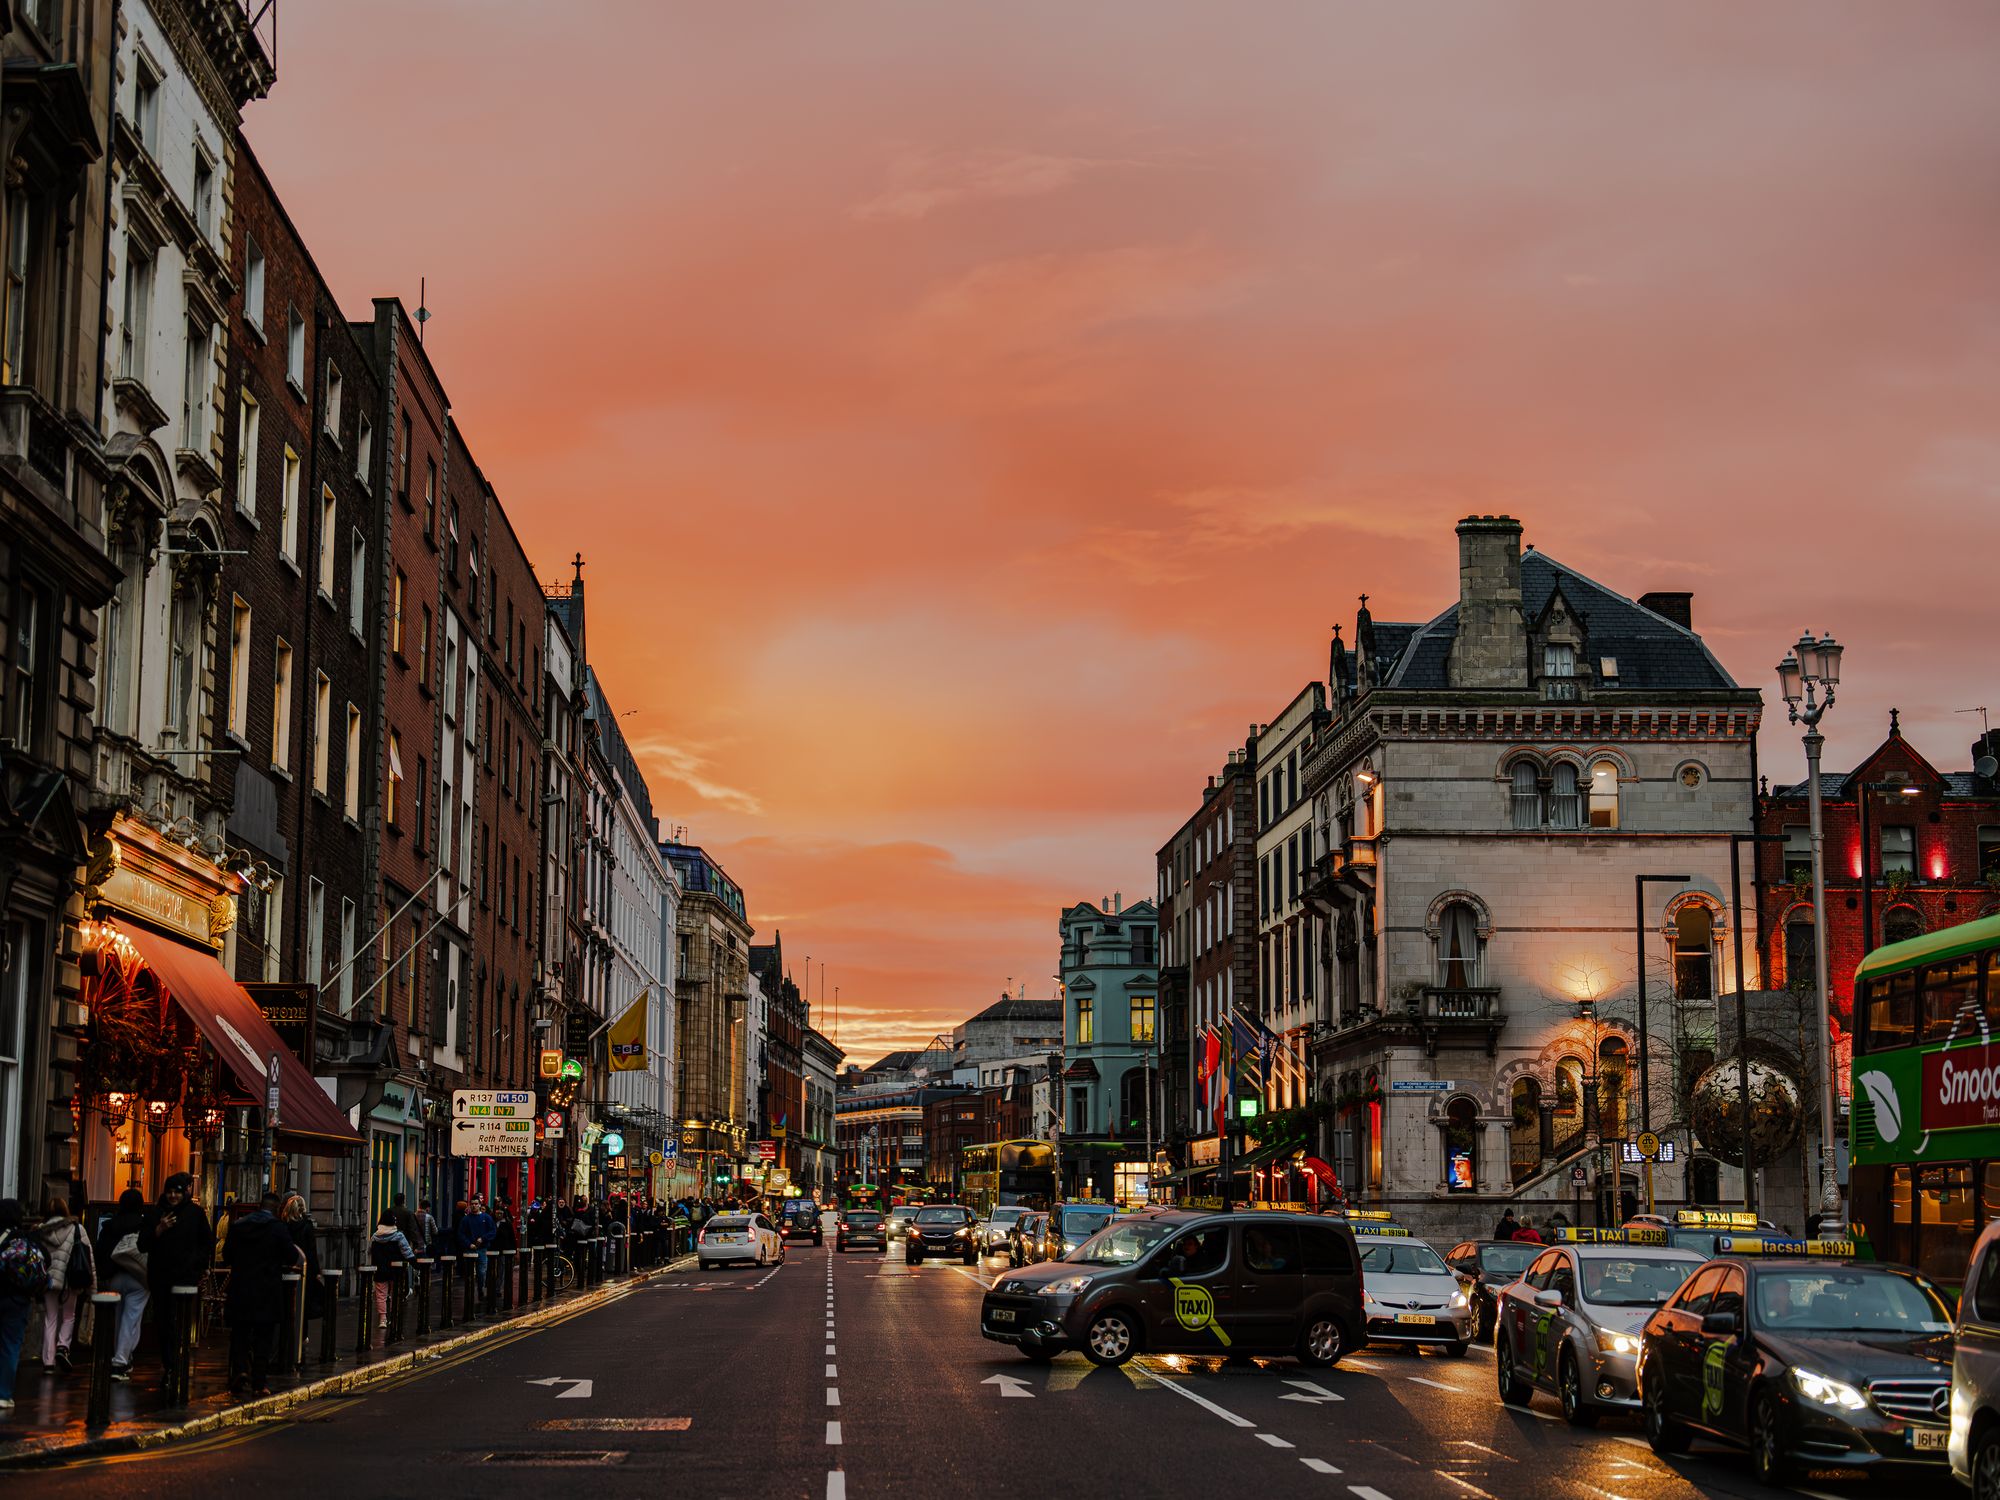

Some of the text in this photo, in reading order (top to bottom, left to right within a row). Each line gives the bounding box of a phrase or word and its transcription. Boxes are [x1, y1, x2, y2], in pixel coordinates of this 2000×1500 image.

[261, 1006, 307, 1019] STONE
[478, 1135, 529, 1143] Rath Maonais
[479, 1145, 527, 1153] RATHMINES
[667, 1141, 674, 1149] P
[1270, 1202, 1288, 1210] TAXI
[1705, 1212, 1731, 1223] TAXI
[1357, 1226, 1380, 1235] TAXI
[1600, 1229, 1625, 1241] TAXI
[1641, 1230, 1666, 1241] 29758
[1721, 1238, 1852, 1255] D tacsai 19037
[1180, 1299, 1208, 1315] TAXI
